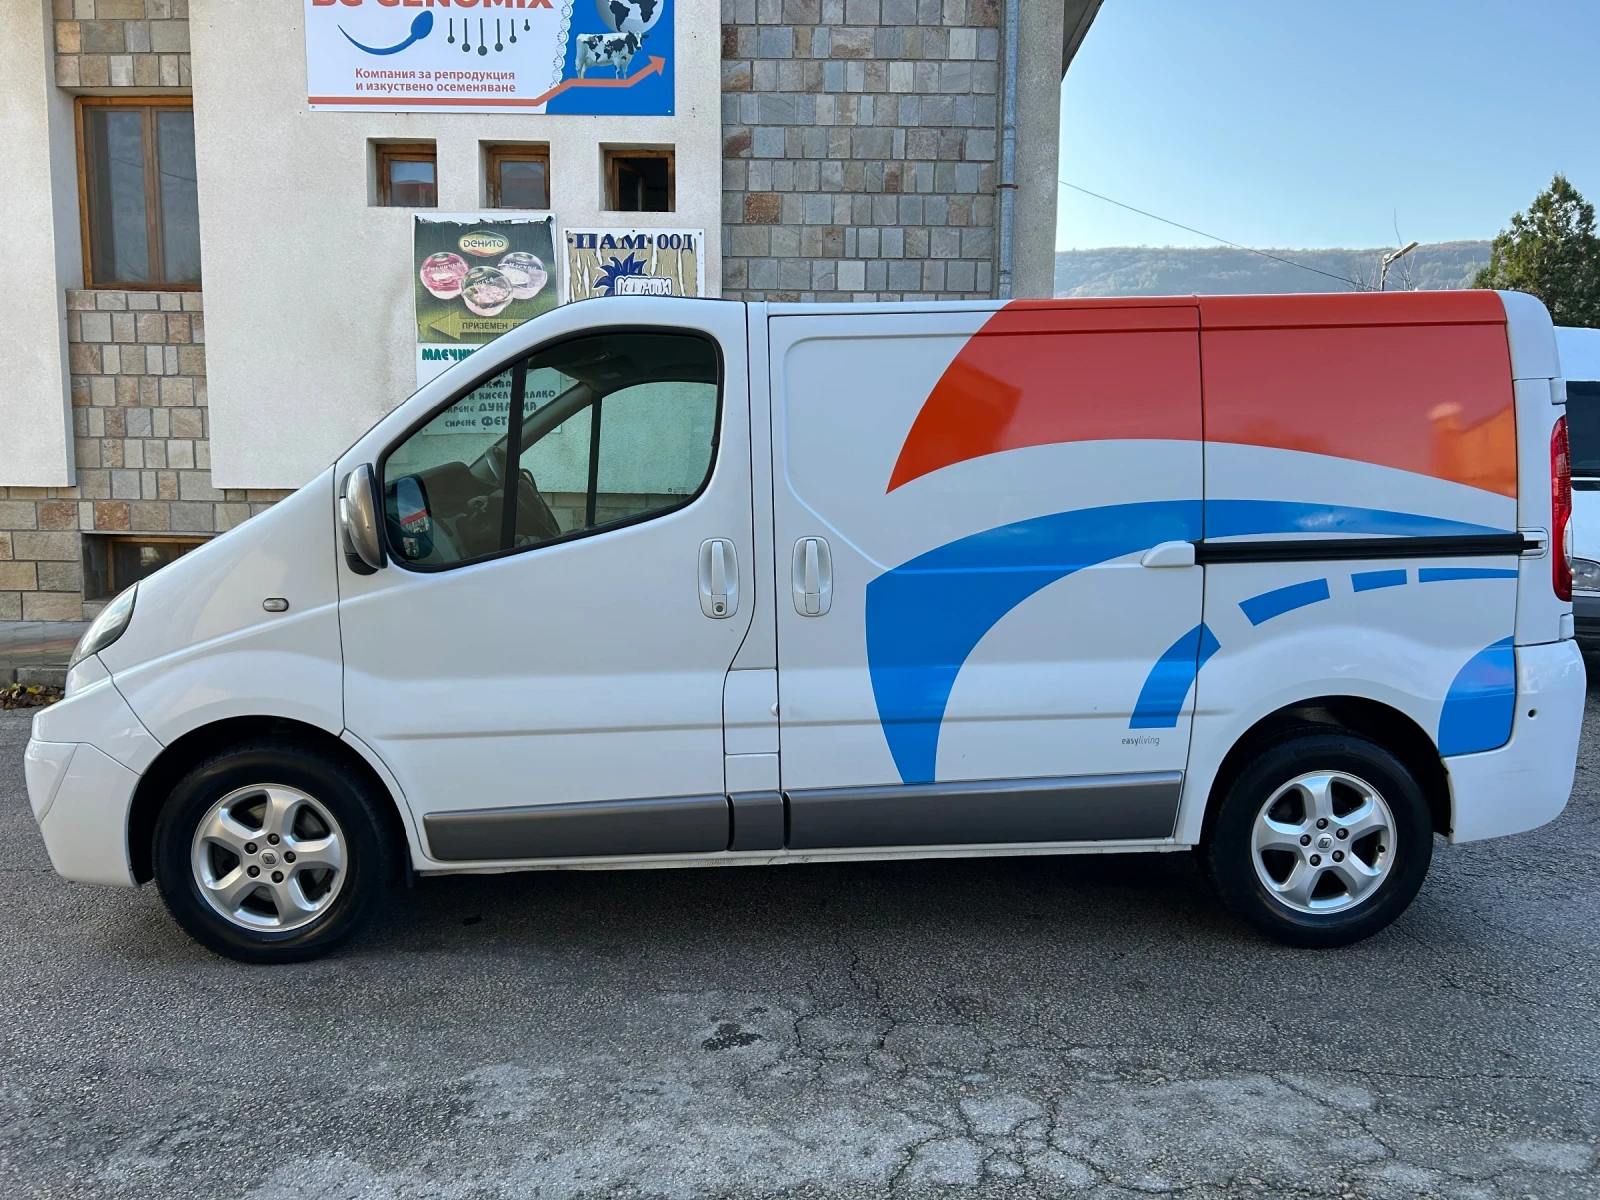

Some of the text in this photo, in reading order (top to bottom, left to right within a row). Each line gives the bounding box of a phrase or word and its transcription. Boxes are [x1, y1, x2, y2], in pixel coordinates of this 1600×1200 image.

[355, 68, 515, 82] Компания за репродукция
[366, 82, 434, 93] изкуствено
[436, 83, 516, 92] осеменяване
[656, 233, 693, 254] ООД
[462, 322, 508, 330] ПРИЗЕМЕН
[479, 391, 510, 400] КИСЕЛ
[445, 405, 474, 413] ИРЕНЕ
[445, 416, 508, 427] СИРЕНЕ ФЕТ
[1121, 736, 1160, 746] easyliving
